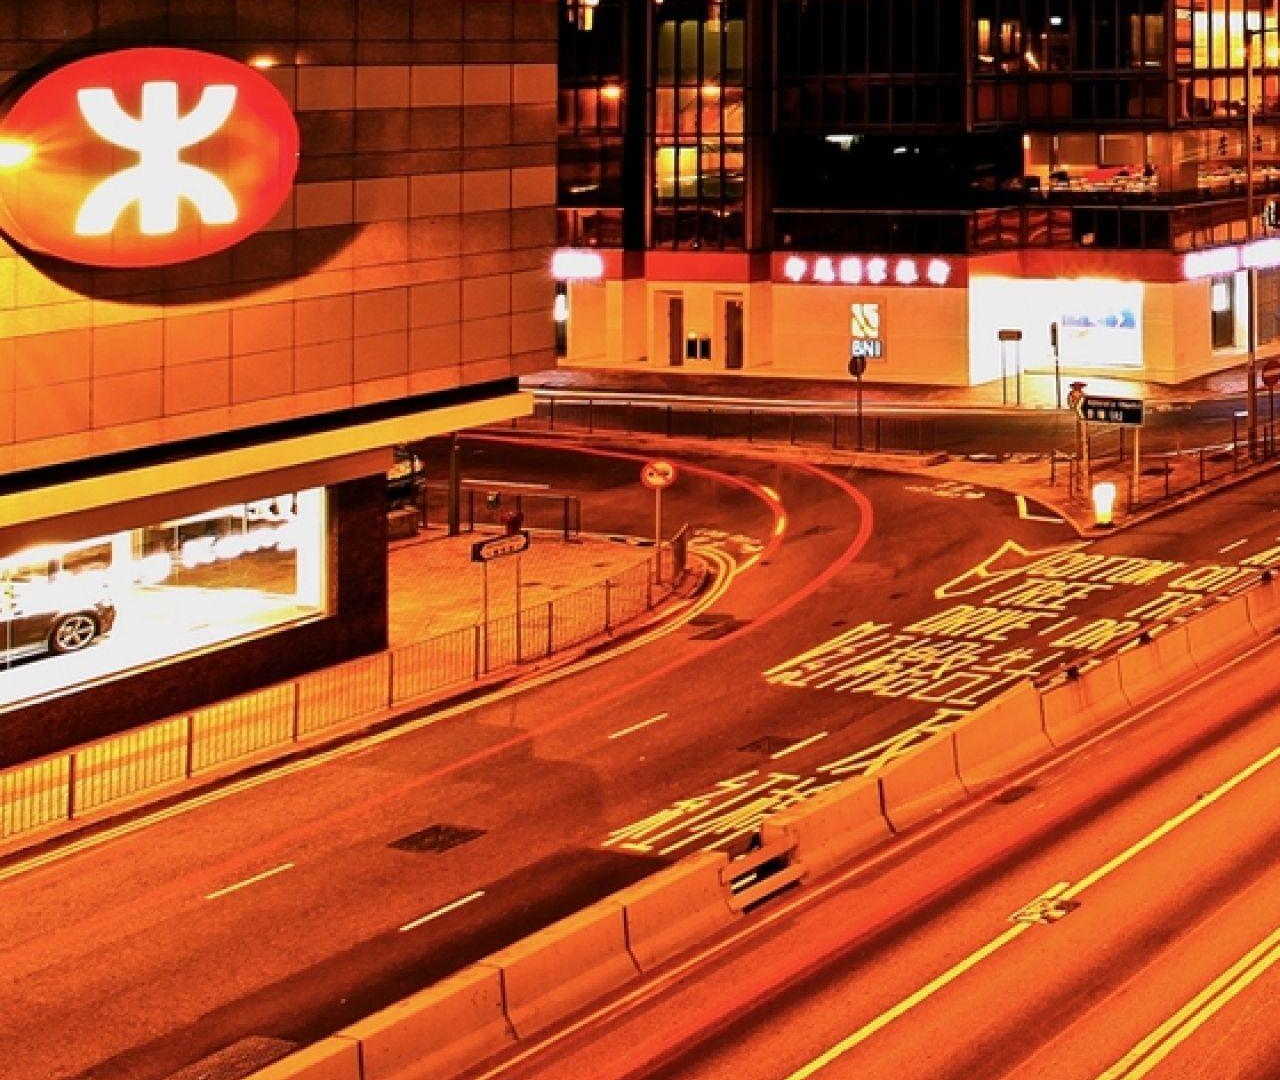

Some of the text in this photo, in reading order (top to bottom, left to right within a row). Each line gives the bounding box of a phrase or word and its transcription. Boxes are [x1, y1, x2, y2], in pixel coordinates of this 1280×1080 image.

[1026, 552, 1188, 586] COTTON
[983, 578, 1114, 611] TREE
[901, 605, 1060, 641] DRIVE
